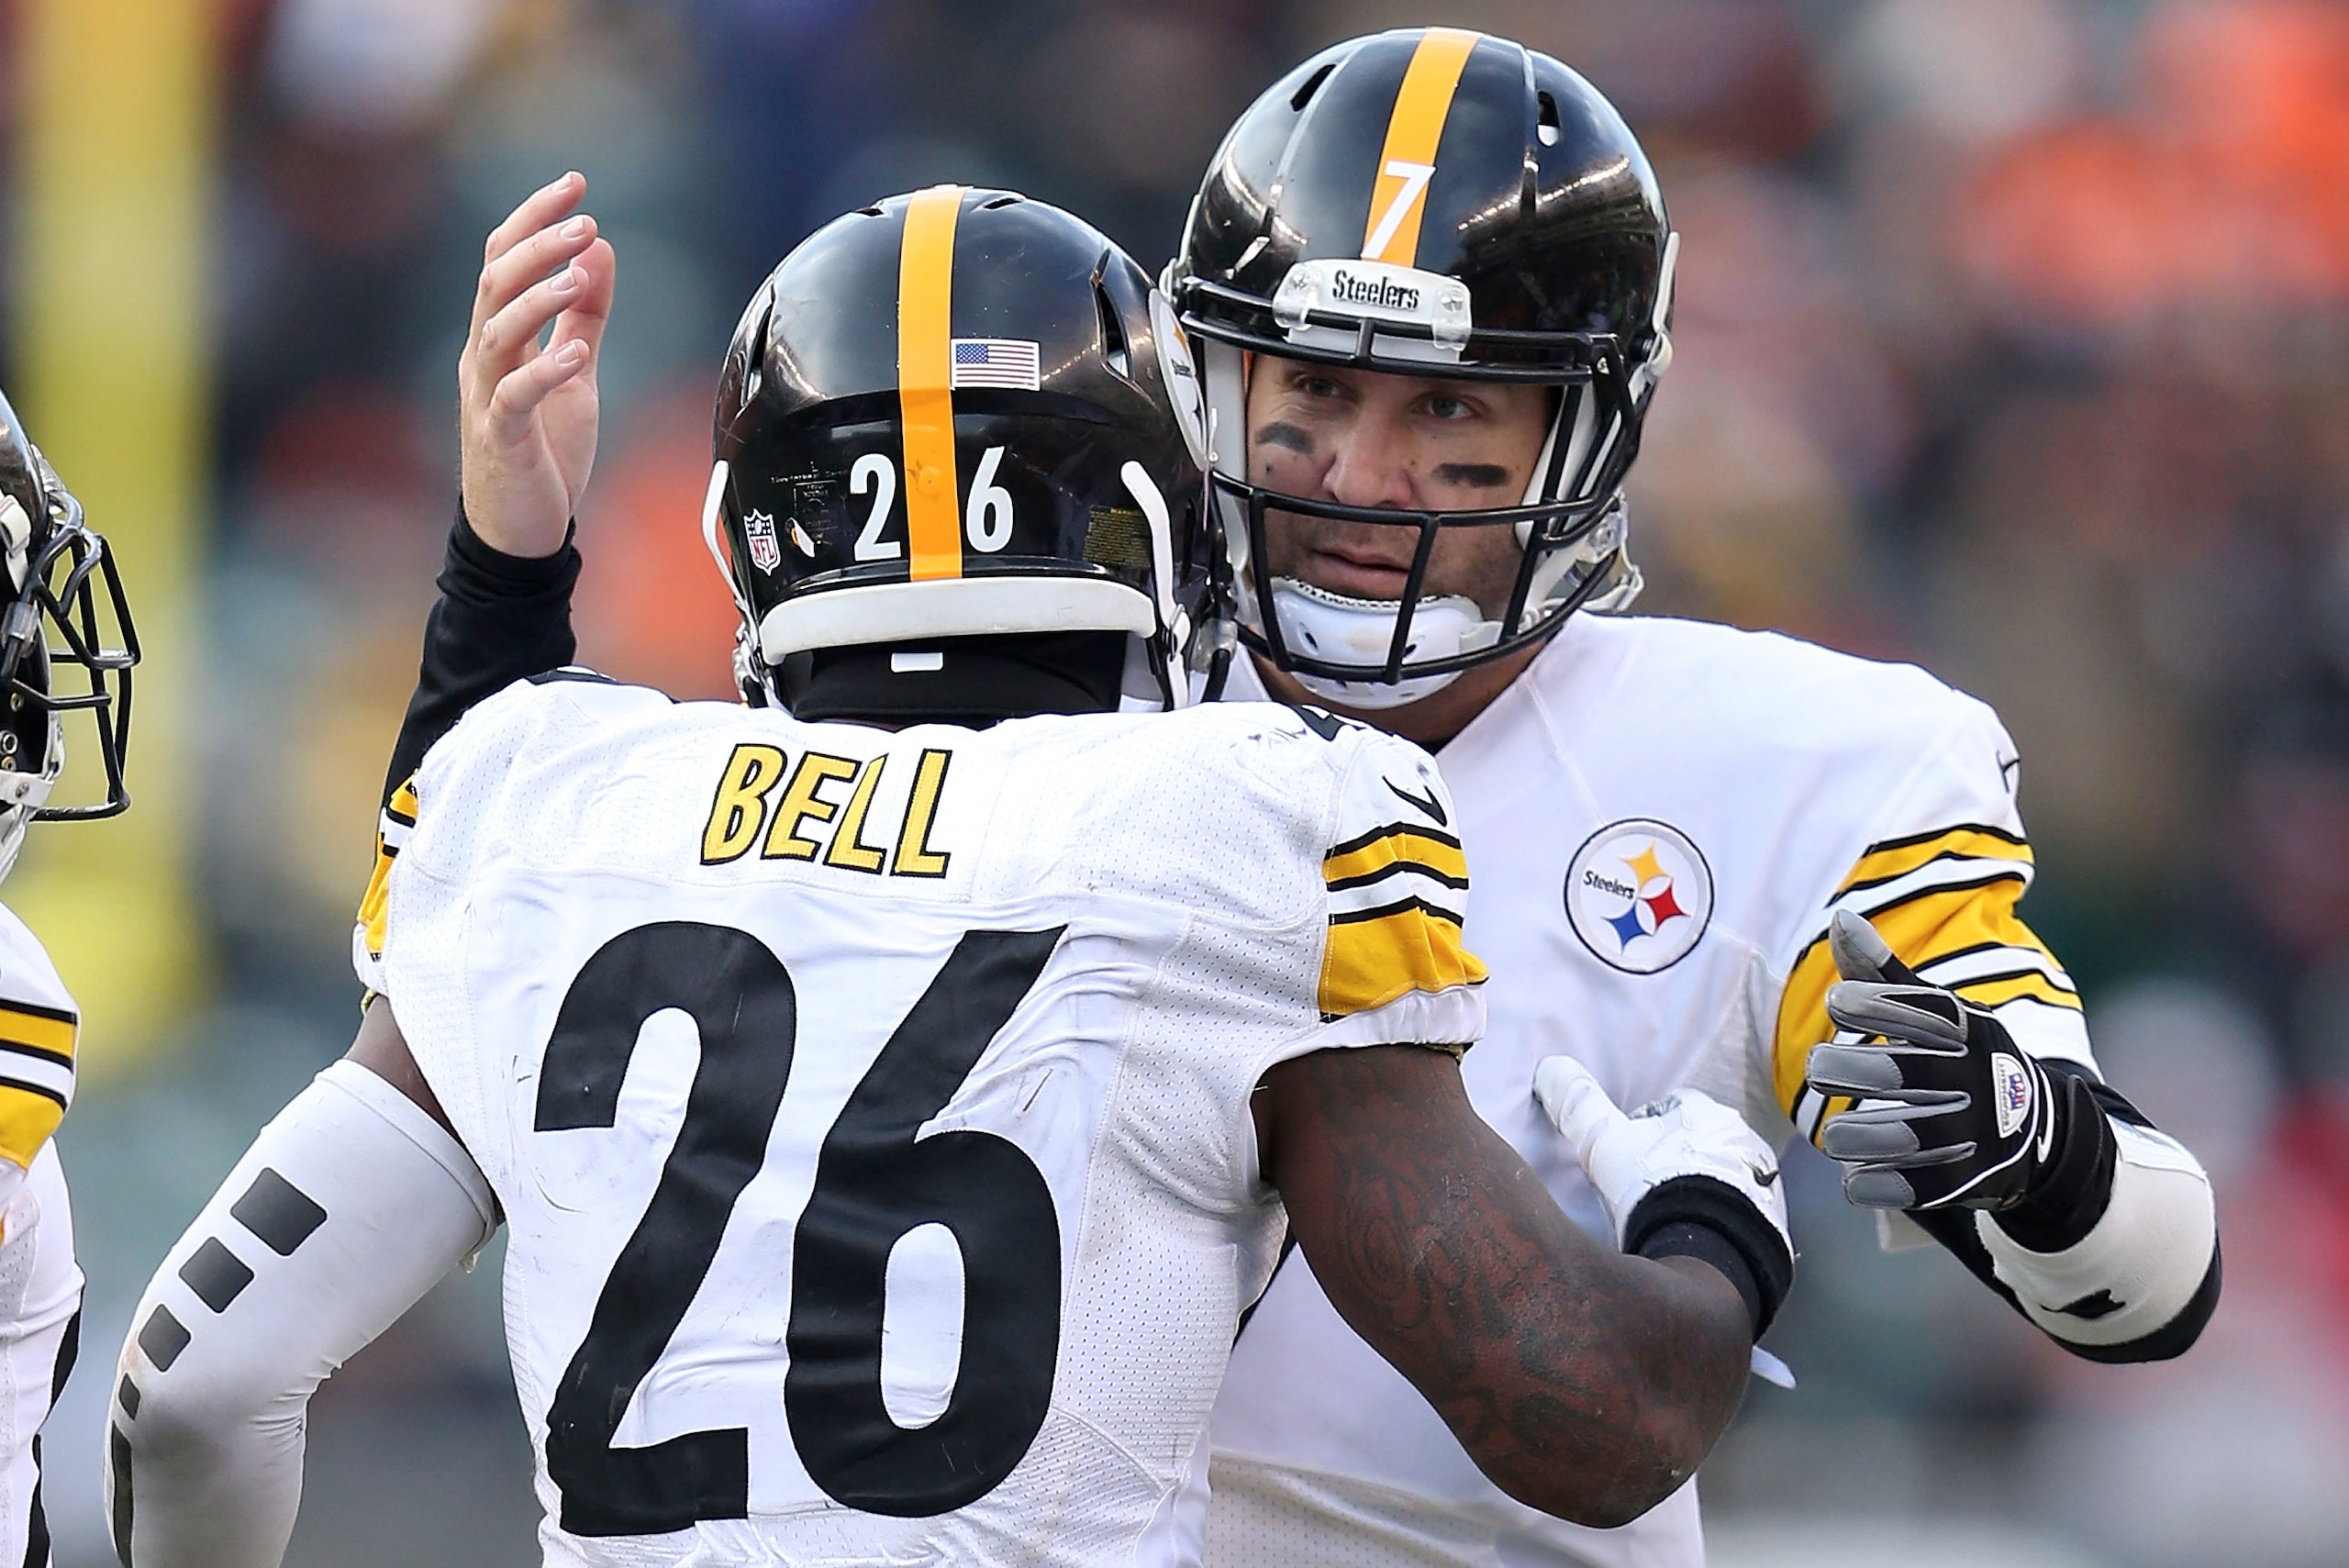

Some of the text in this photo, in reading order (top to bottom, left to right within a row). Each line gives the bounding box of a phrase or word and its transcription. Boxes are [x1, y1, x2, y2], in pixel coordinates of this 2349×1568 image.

[1360, 160, 1437, 260] 7
[1332, 269, 1420, 309] Steelers
[751, 538, 775, 562] NFL
[699, 742, 953, 879] BELL
[1584, 871, 1635, 899] Steelers
[534, 920, 1068, 1538] 26
